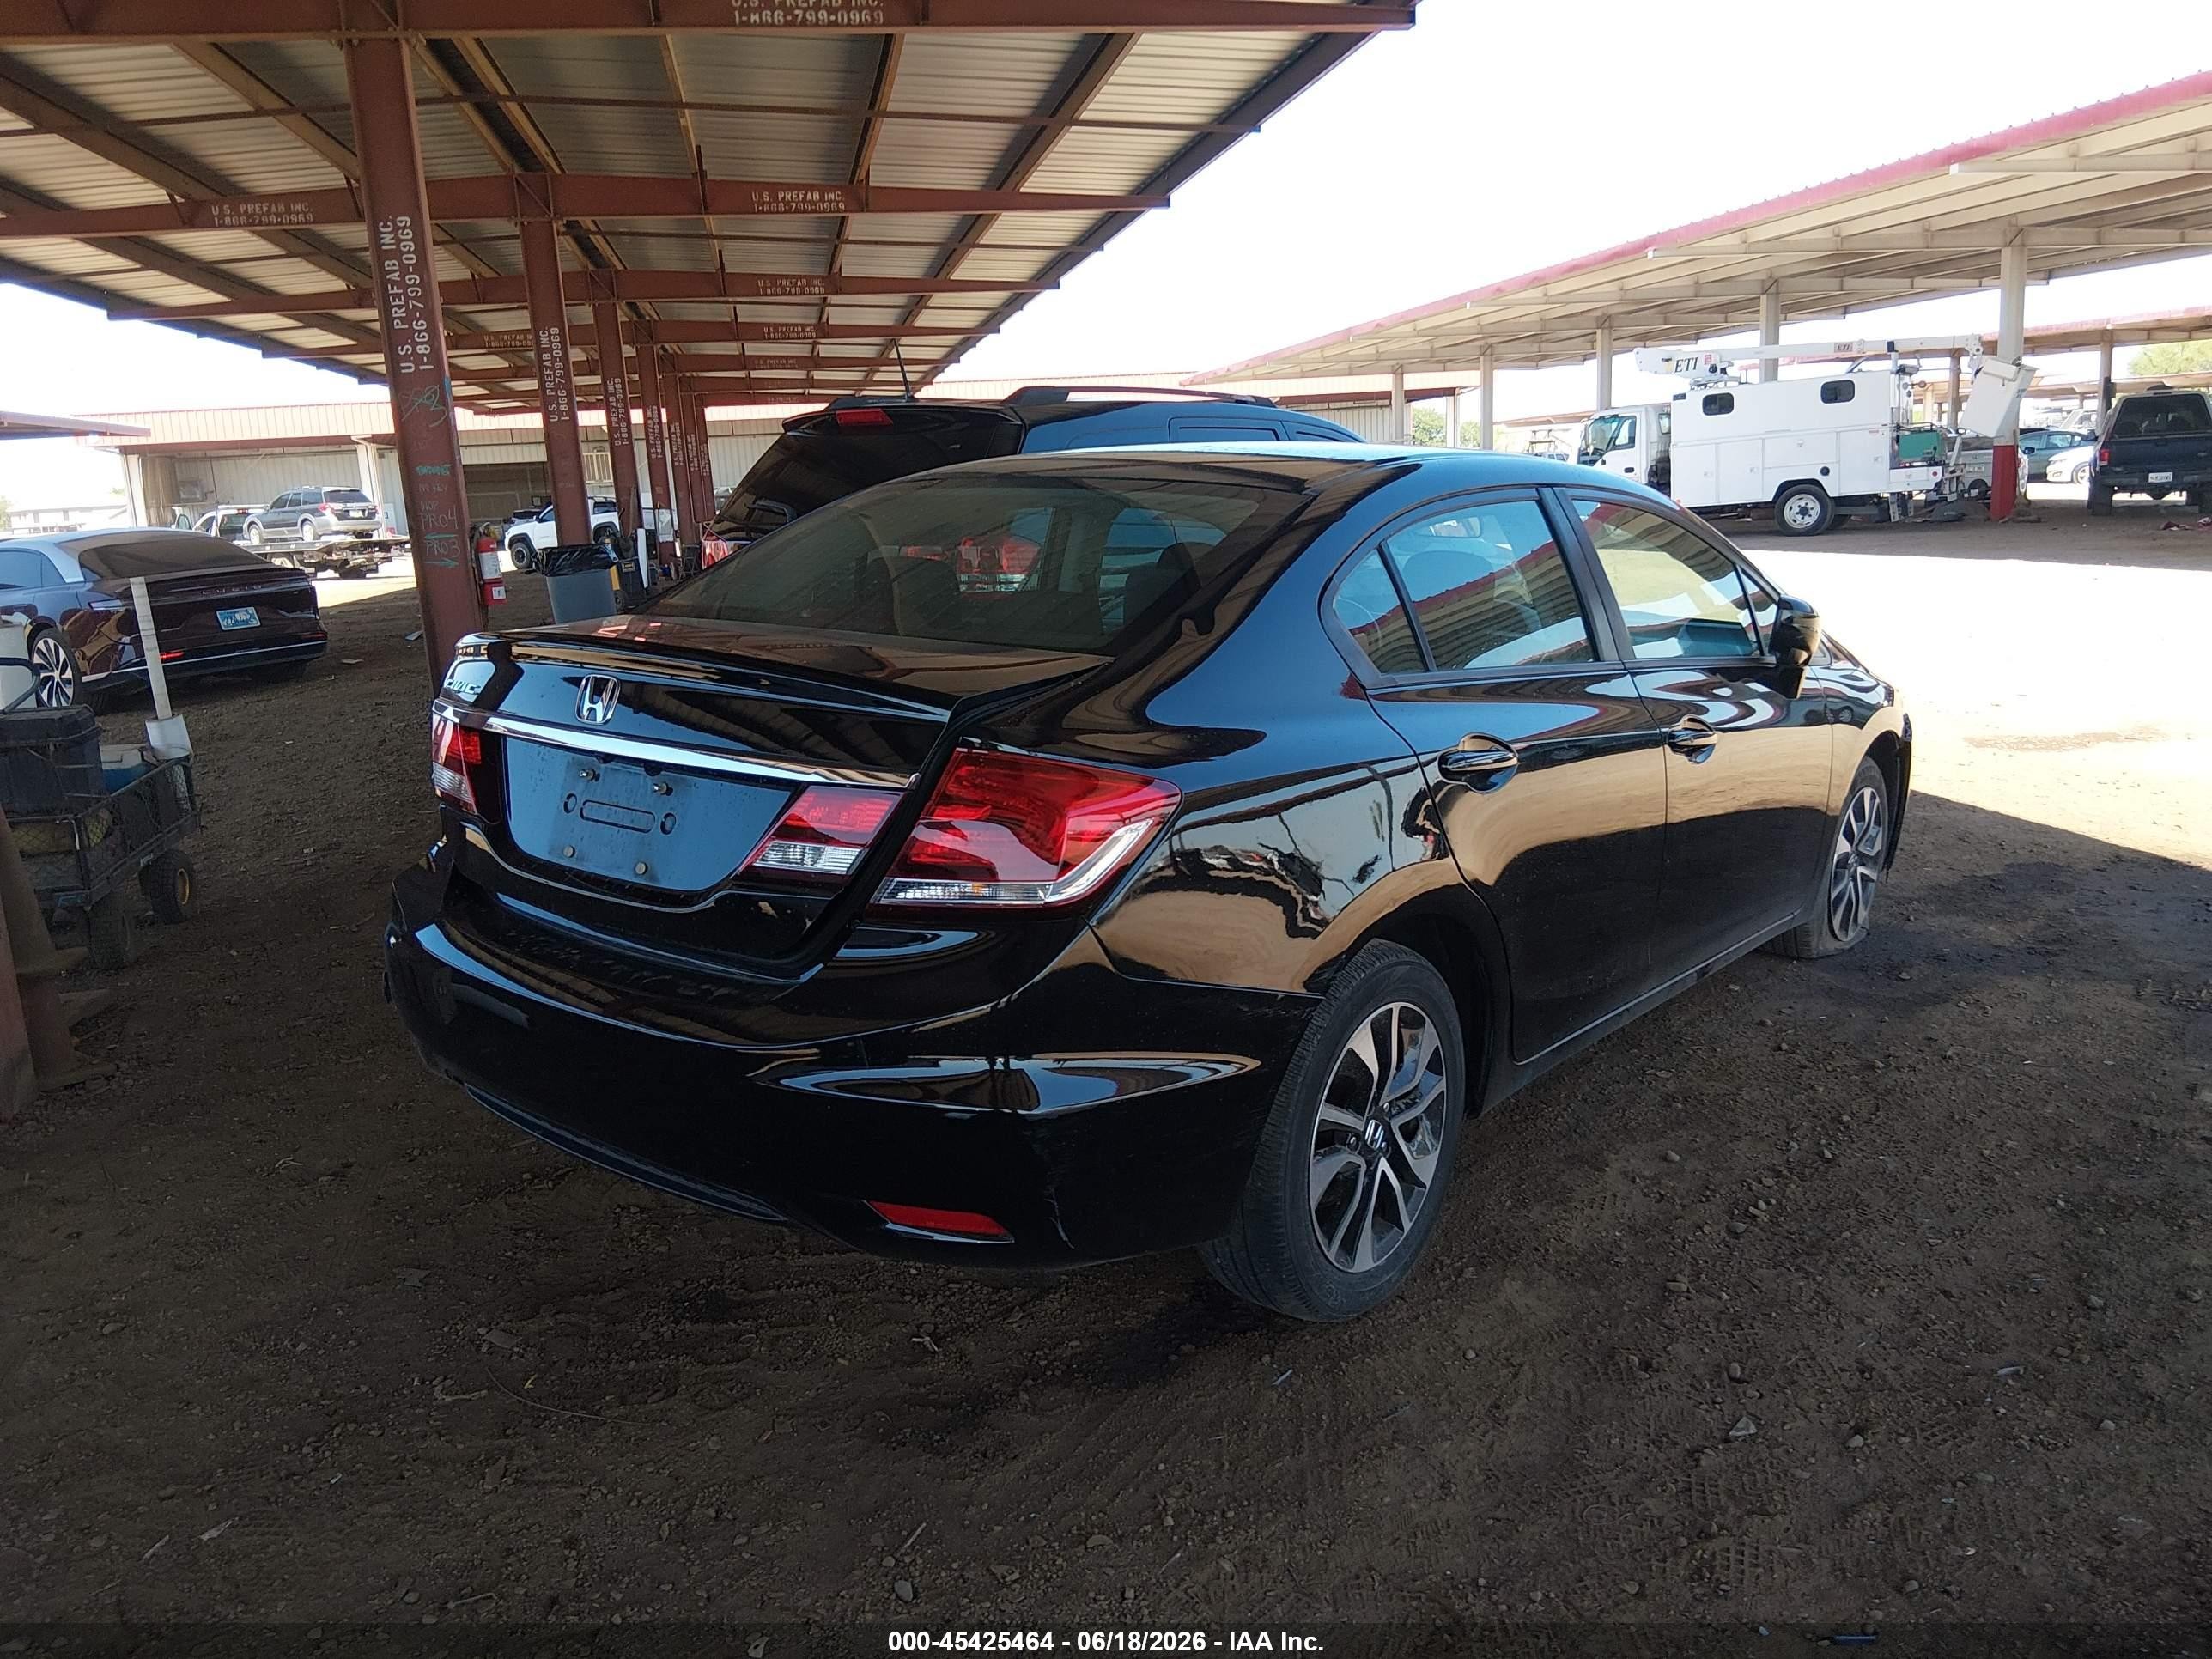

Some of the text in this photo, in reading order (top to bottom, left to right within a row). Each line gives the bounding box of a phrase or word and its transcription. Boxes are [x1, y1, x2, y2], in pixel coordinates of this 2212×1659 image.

[752, 191, 773, 202] U.S.
[778, 190, 820, 202] PREFAB
[379, 215, 415, 374] U.S. PREFAB INC.
[397, 216, 434, 370] 1-866-799-0969
[539, 326, 559, 422] U.S. PREFAB INC.
[550, 327, 570, 421] 1-866-799-0969
[1674, 356, 1698, 374] ETI
[609, 397, 619, 427] PREFAB
[420, 504, 459, 530] PRO4
[425, 538, 461, 558] PRO3
[446, 678, 477, 695] CIVIC
